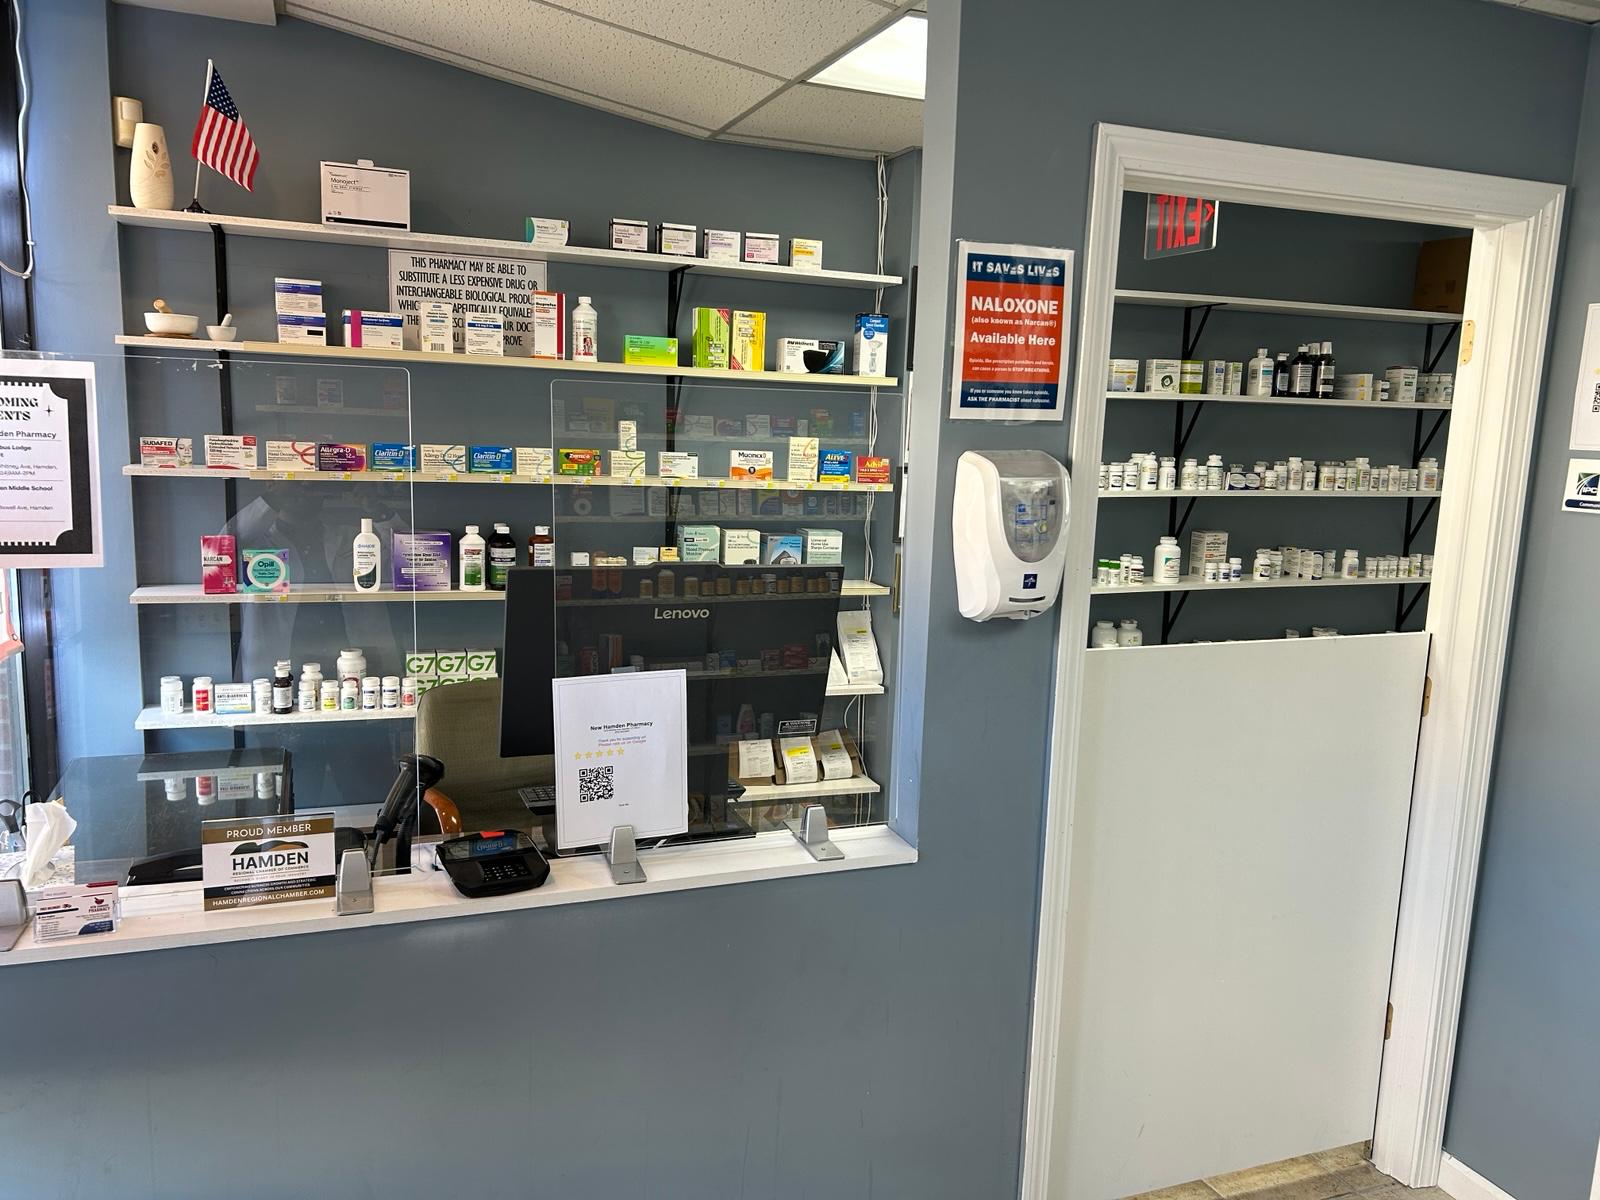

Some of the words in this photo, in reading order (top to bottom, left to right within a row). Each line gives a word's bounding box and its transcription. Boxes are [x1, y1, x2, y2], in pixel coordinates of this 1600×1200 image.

[411, 256, 426, 268] THIS
[429, 258, 467, 271] PHARMACY
[469, 262, 484, 273] MAY
[486, 263, 495, 273] BE
[497, 263, 515, 275] ABLE
[517, 265, 527, 276] TO
[972, 261, 983, 272] IT
[399, 271, 440, 284] SUBSTITUTE
[442, 274, 448, 284] A
[450, 274, 465, 286] LESS
[468, 276, 503, 289] EXPENSIVE
[505, 279, 526, 290] DRUG
[527, 280, 538, 291] OR
[396, 285, 463, 300] INTERCHANGEABLE
[465, 290, 506, 303] BIOLOGICAL
[971, 296, 1058, 315] NALOXONE
[971, 316, 989, 325] (also
[990, 316, 1014, 325] known
[970, 331, 1025, 345] Available
[1028, 334, 1056, 346] Here
[16, 430, 56, 439] Pharmacy
[654, 607, 710, 619] Lenovo
[407, 657, 436, 673] G7
[437, 656, 466, 673] G7
[468, 655, 496, 671] G7
[226, 828, 264, 838] PROUD
[267, 823, 312, 836] MEMBER
[232, 851, 309, 870] HAMDEN
[212, 888, 325, 906] HAMDENREGIONALCHAMBER.COM
